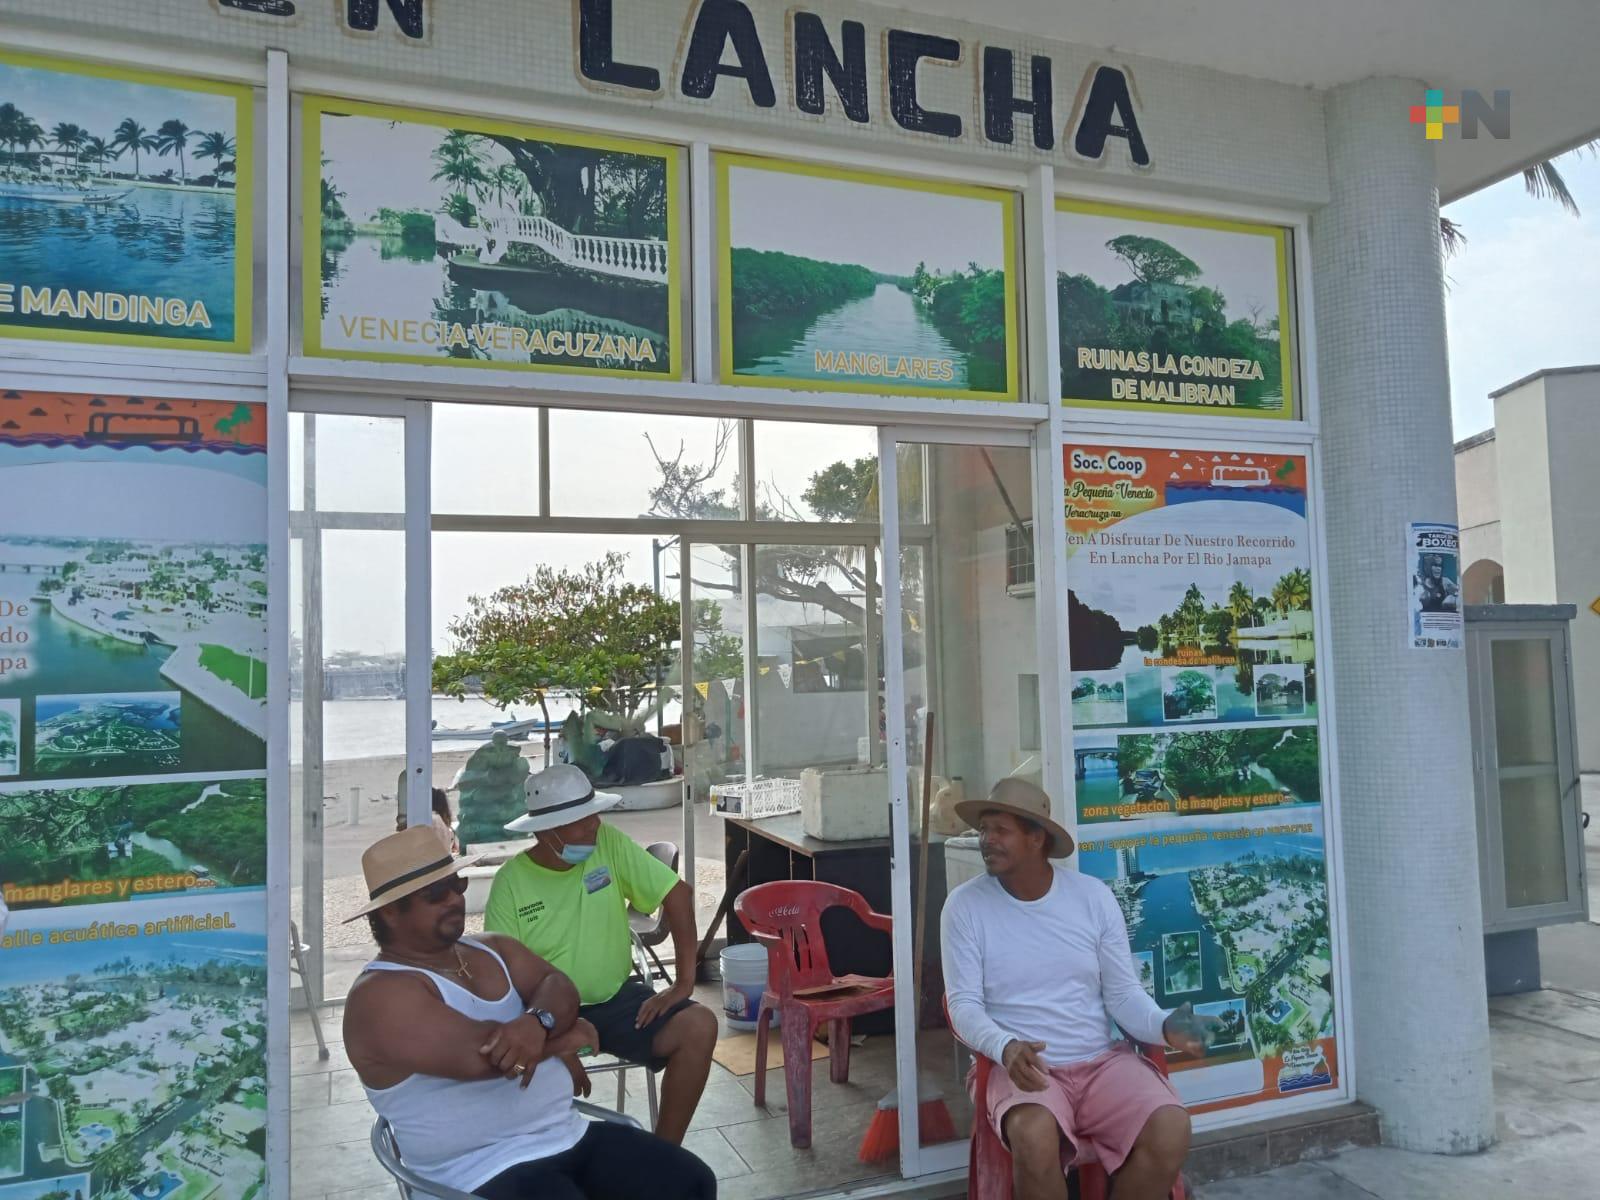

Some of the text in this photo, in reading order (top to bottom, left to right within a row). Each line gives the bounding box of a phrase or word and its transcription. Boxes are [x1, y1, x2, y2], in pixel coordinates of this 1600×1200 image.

[578, 0, 1150, 166] LANCHA
[21, 285, 212, 328] MANDINGA
[339, 314, 657, 363] VENECIA VERACUZANA
[815, 350, 954, 381] MANGLARES
[1077, 347, 1264, 380] RUINAS LA CONDEZA
[1112, 378, 1235, 405] DE MALIBRAN
[1073, 454, 1143, 474] Soc. Coop
[1072, 481, 1114, 502] Pequeña
[1115, 482, 1155, 499] Venecia
[1088, 533, 1097, 546] A
[1101, 532, 1160, 546] Disfrutar
[1165, 534, 1181, 546] De
[1184, 534, 1233, 547] Nuestro
[1237, 535, 1295, 548] Recorrido
[1423, 538, 1457, 548] BOXEO
[1090, 552, 1107, 564] En
[1112, 552, 1159, 564] Lancha
[1163, 552, 1183, 564] Por
[1187, 553, 1200, 565] El
[1226, 553, 1272, 568] Jamapa
[0, 600, 28, 617] De
[0, 626, 28, 643] do
[0, 657, 27, 674] pa
[1083, 807, 1109, 817] zona
[1175, 800, 1187, 810] de
[1190, 795, 1244, 809] manglares
[1245, 798, 1250, 807] y
[1150, 835, 1159, 845] la
[1162, 831, 1207, 847] pequeña
[1212, 827, 1250, 839] venecia
[3, 878, 113, 903] manglares
[119, 879, 130, 896] y
[1, 912, 237, 948] alle acuática artificial.
